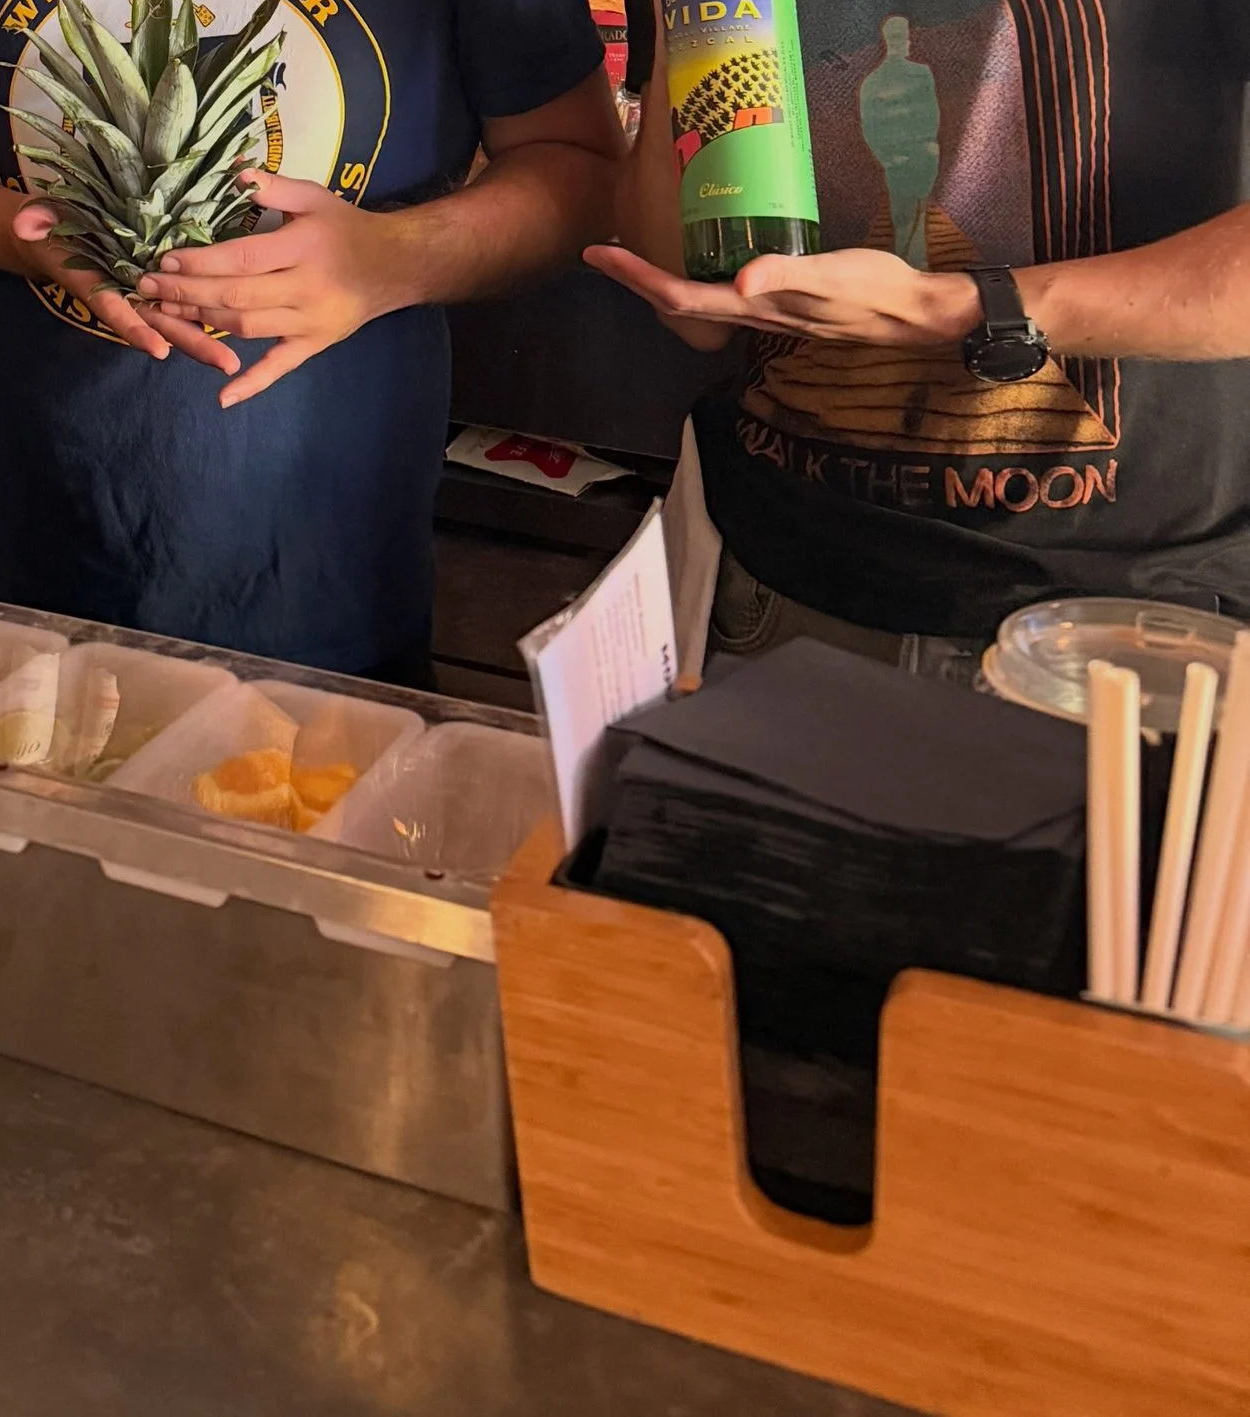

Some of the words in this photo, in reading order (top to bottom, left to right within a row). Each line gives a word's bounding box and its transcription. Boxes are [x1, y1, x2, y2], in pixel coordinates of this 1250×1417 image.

[700, 23, 754, 34] VILLAGE
[840, 456, 931, 507] THE
[944, 458, 1119, 513] MOON
